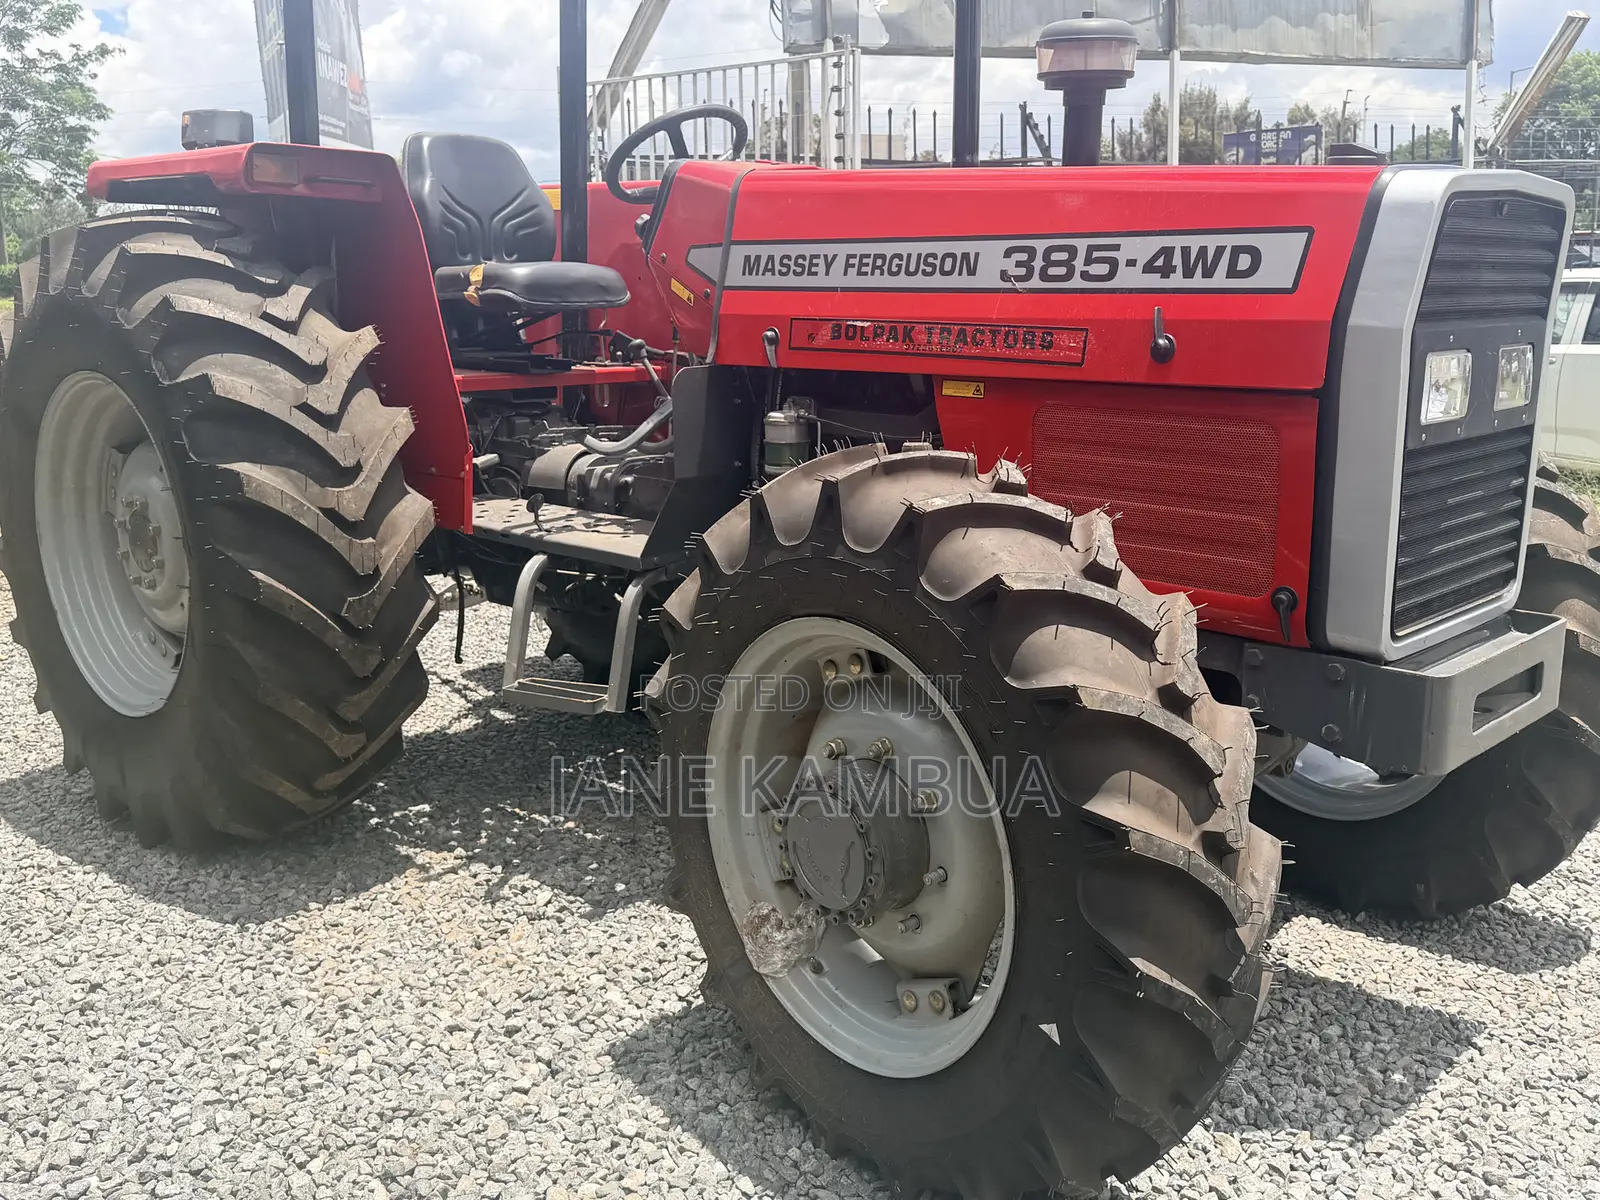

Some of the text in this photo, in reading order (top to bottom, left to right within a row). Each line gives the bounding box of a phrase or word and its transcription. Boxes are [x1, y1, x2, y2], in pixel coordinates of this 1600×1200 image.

[741, 244, 1263, 283] MASSEY FERGUSON 385-4WD
[830, 322, 1056, 351] BOLPAK TRACTORS
